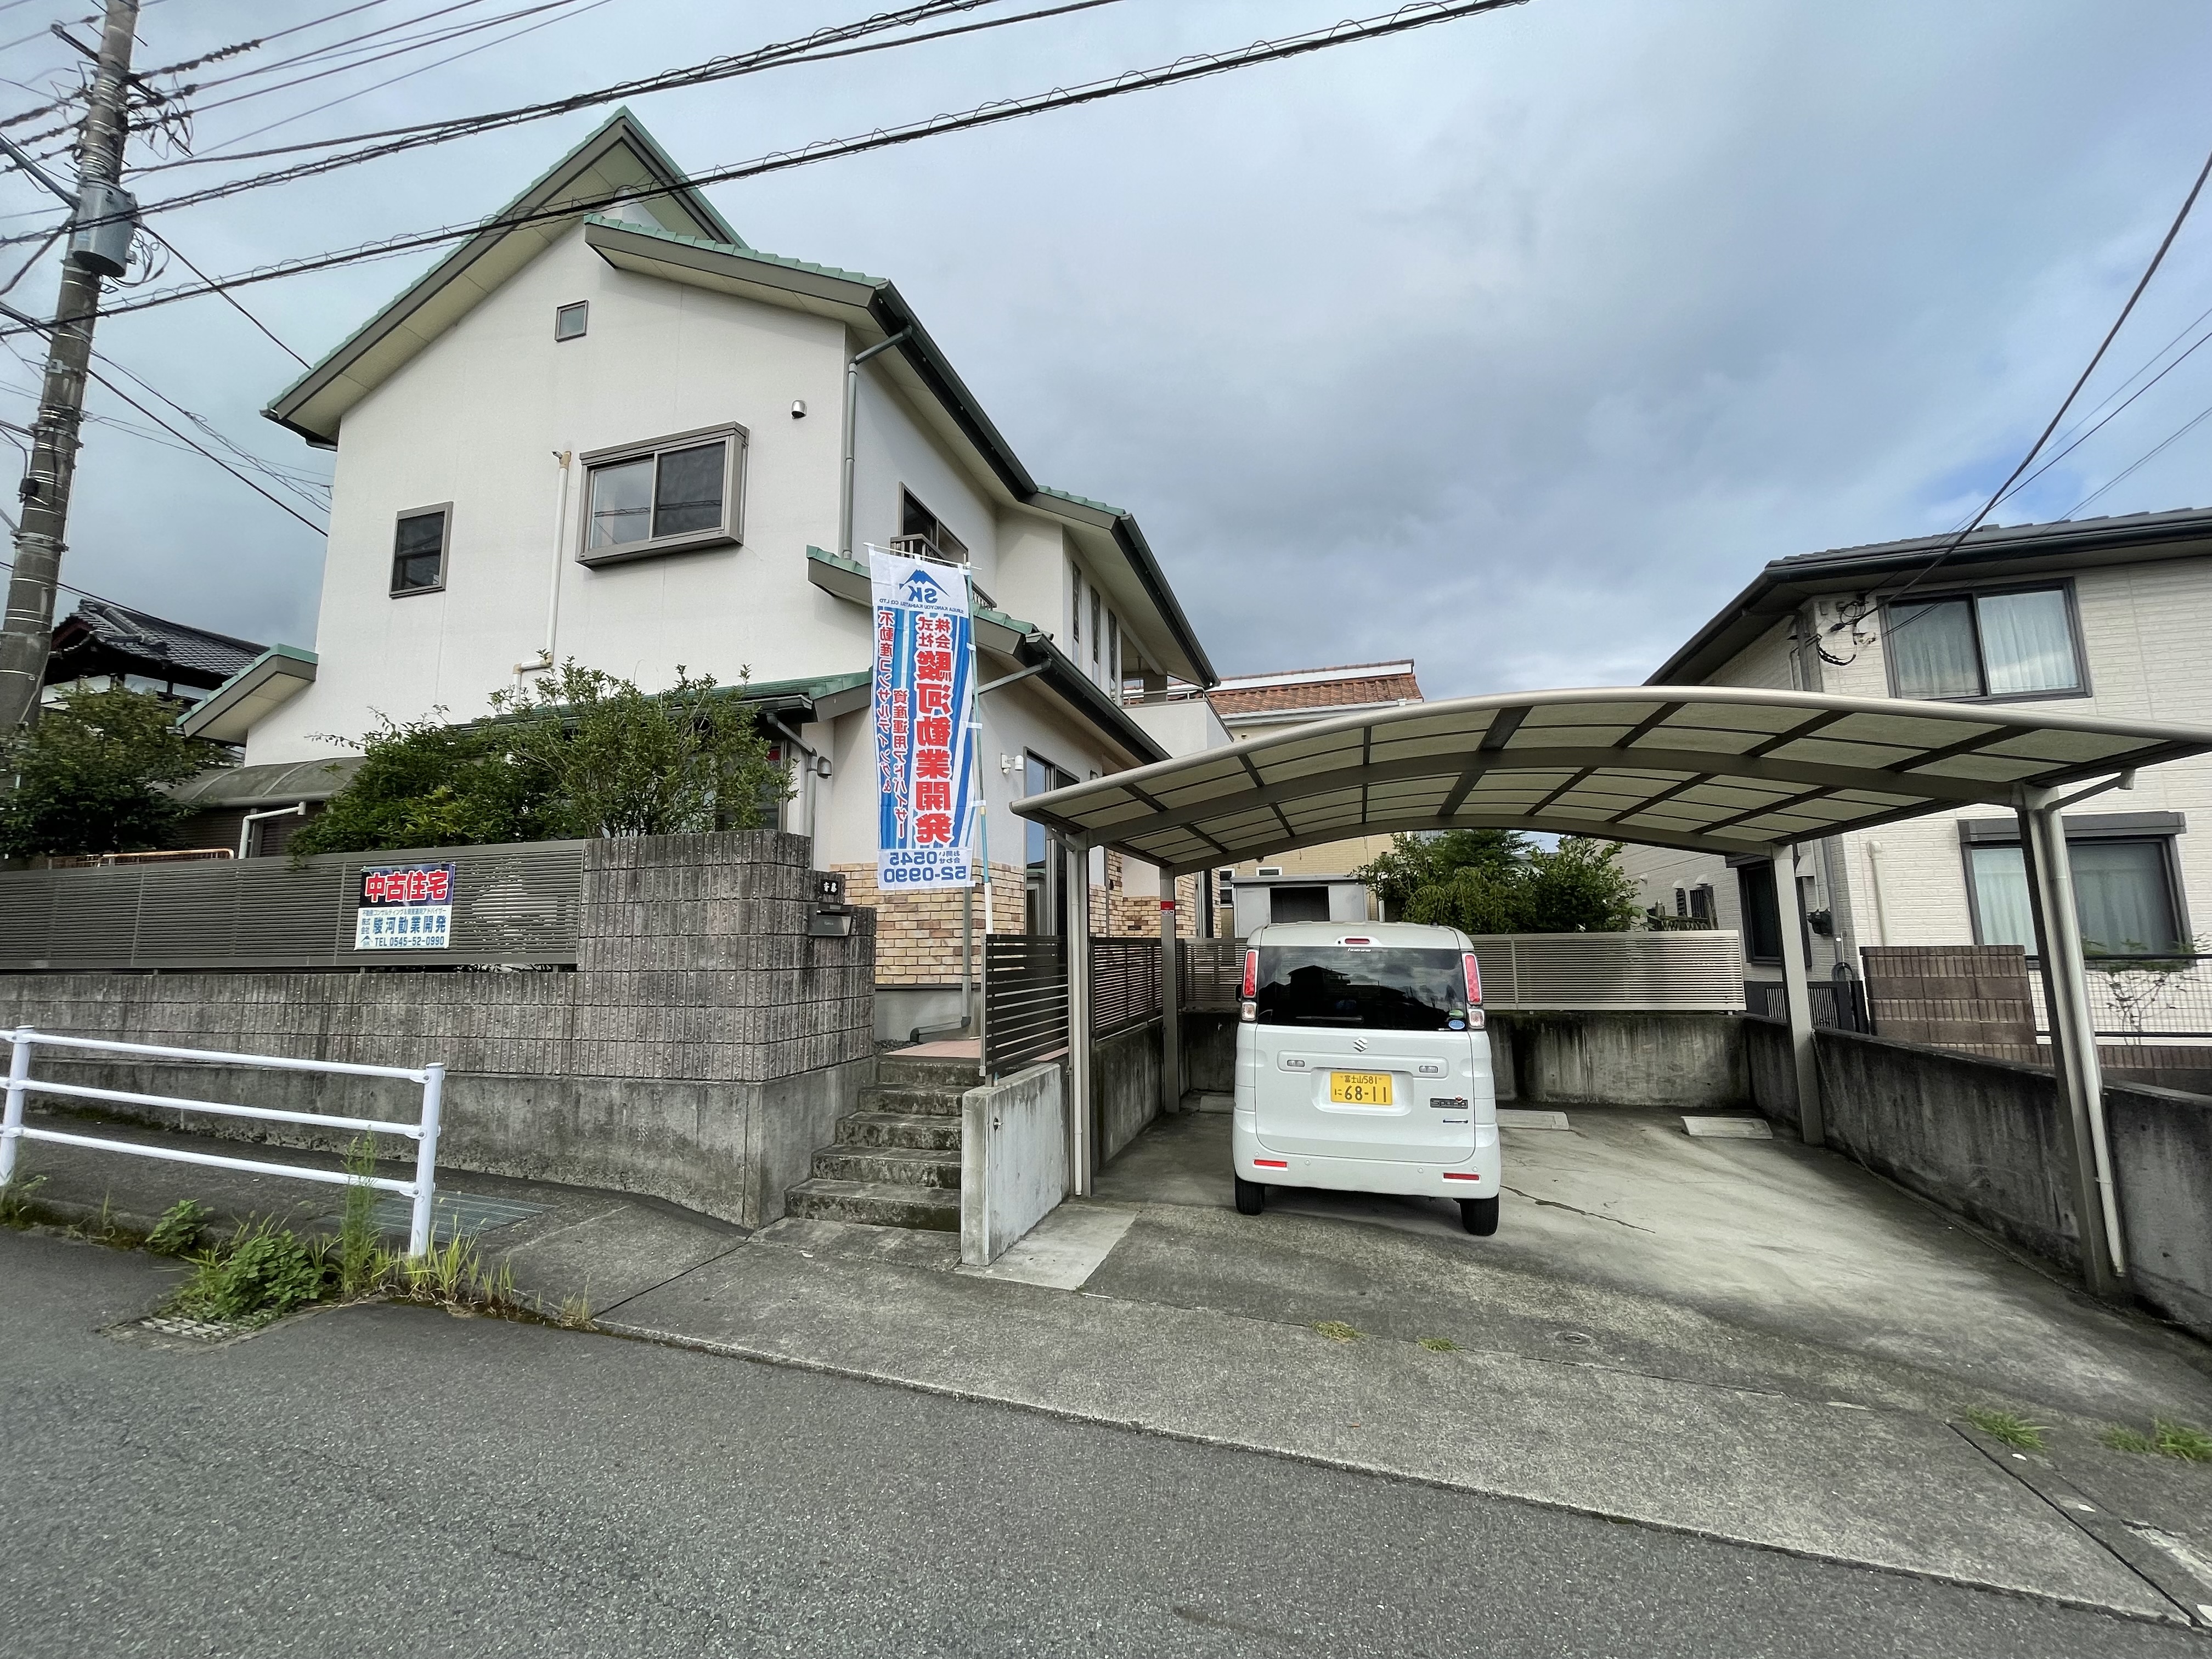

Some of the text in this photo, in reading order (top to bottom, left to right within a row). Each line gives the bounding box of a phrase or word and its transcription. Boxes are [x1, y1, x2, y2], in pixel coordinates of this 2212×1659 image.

[365, 870, 449, 902] 中古住宅
[375, 936, 444, 946] TEL 0545-52-0990
[1345, 1086, 1386, 1102] 68-11
